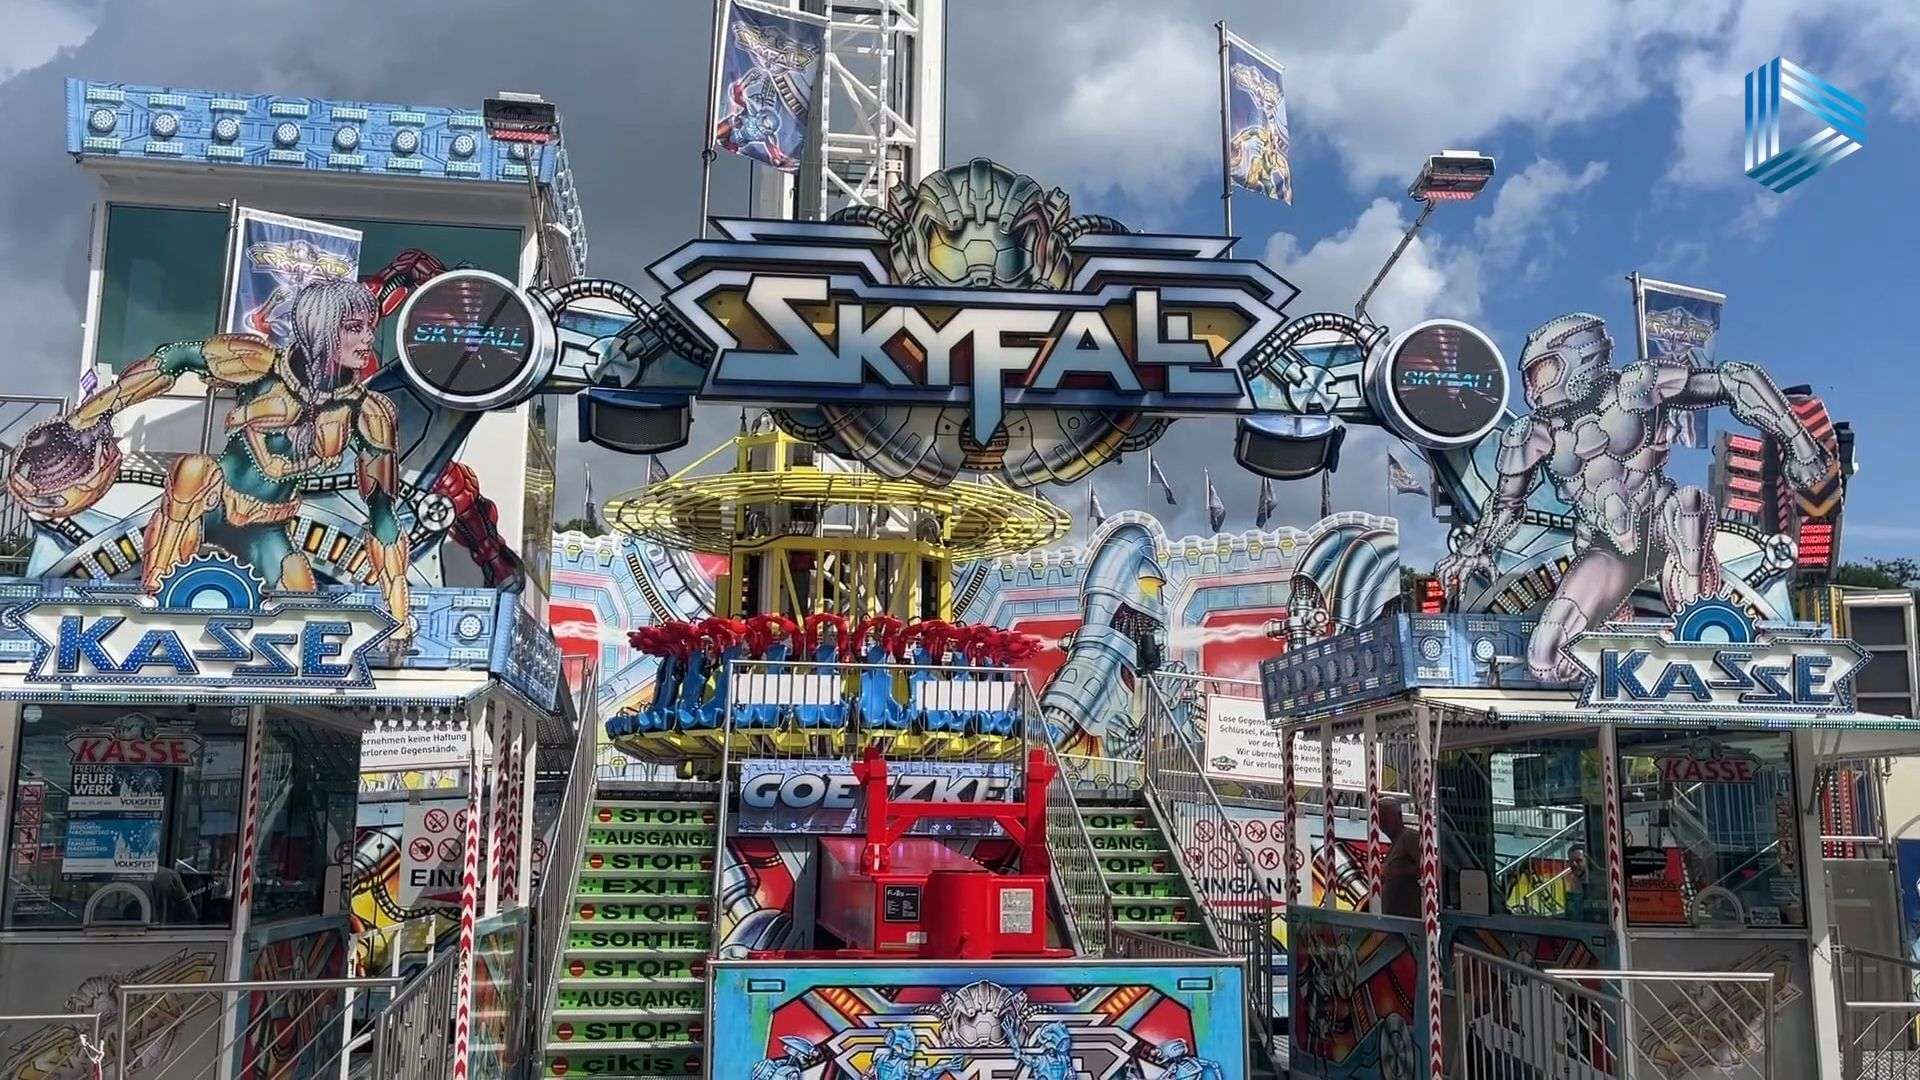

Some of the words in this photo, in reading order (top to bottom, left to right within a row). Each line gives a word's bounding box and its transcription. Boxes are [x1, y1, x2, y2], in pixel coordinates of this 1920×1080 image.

[711, 273, 1246, 448] SKYFALL
[57, 615, 352, 677] KASSE
[1599, 648, 1836, 704] KASSE
[408, 735, 431, 743] keine
[433, 733, 467, 743] Haftung
[76, 740, 189, 763] KASSE
[1664, 758, 1752, 781] KASSE
[74, 774, 114, 784] FEUER
[74, 784, 113, 795] WERK
[619, 808, 698, 824] STOP
[605, 831, 704, 847] AUSGANG
[611, 854, 694, 870] STOP
[602, 879, 695, 895] EXIT
[601, 904, 688, 921] STOP
[591, 931, 696, 948] SORTIE
[592, 959, 685, 978] STOP
[577, 990, 692, 1008] AUSGANG
[584, 1022, 683, 1041] STOP
